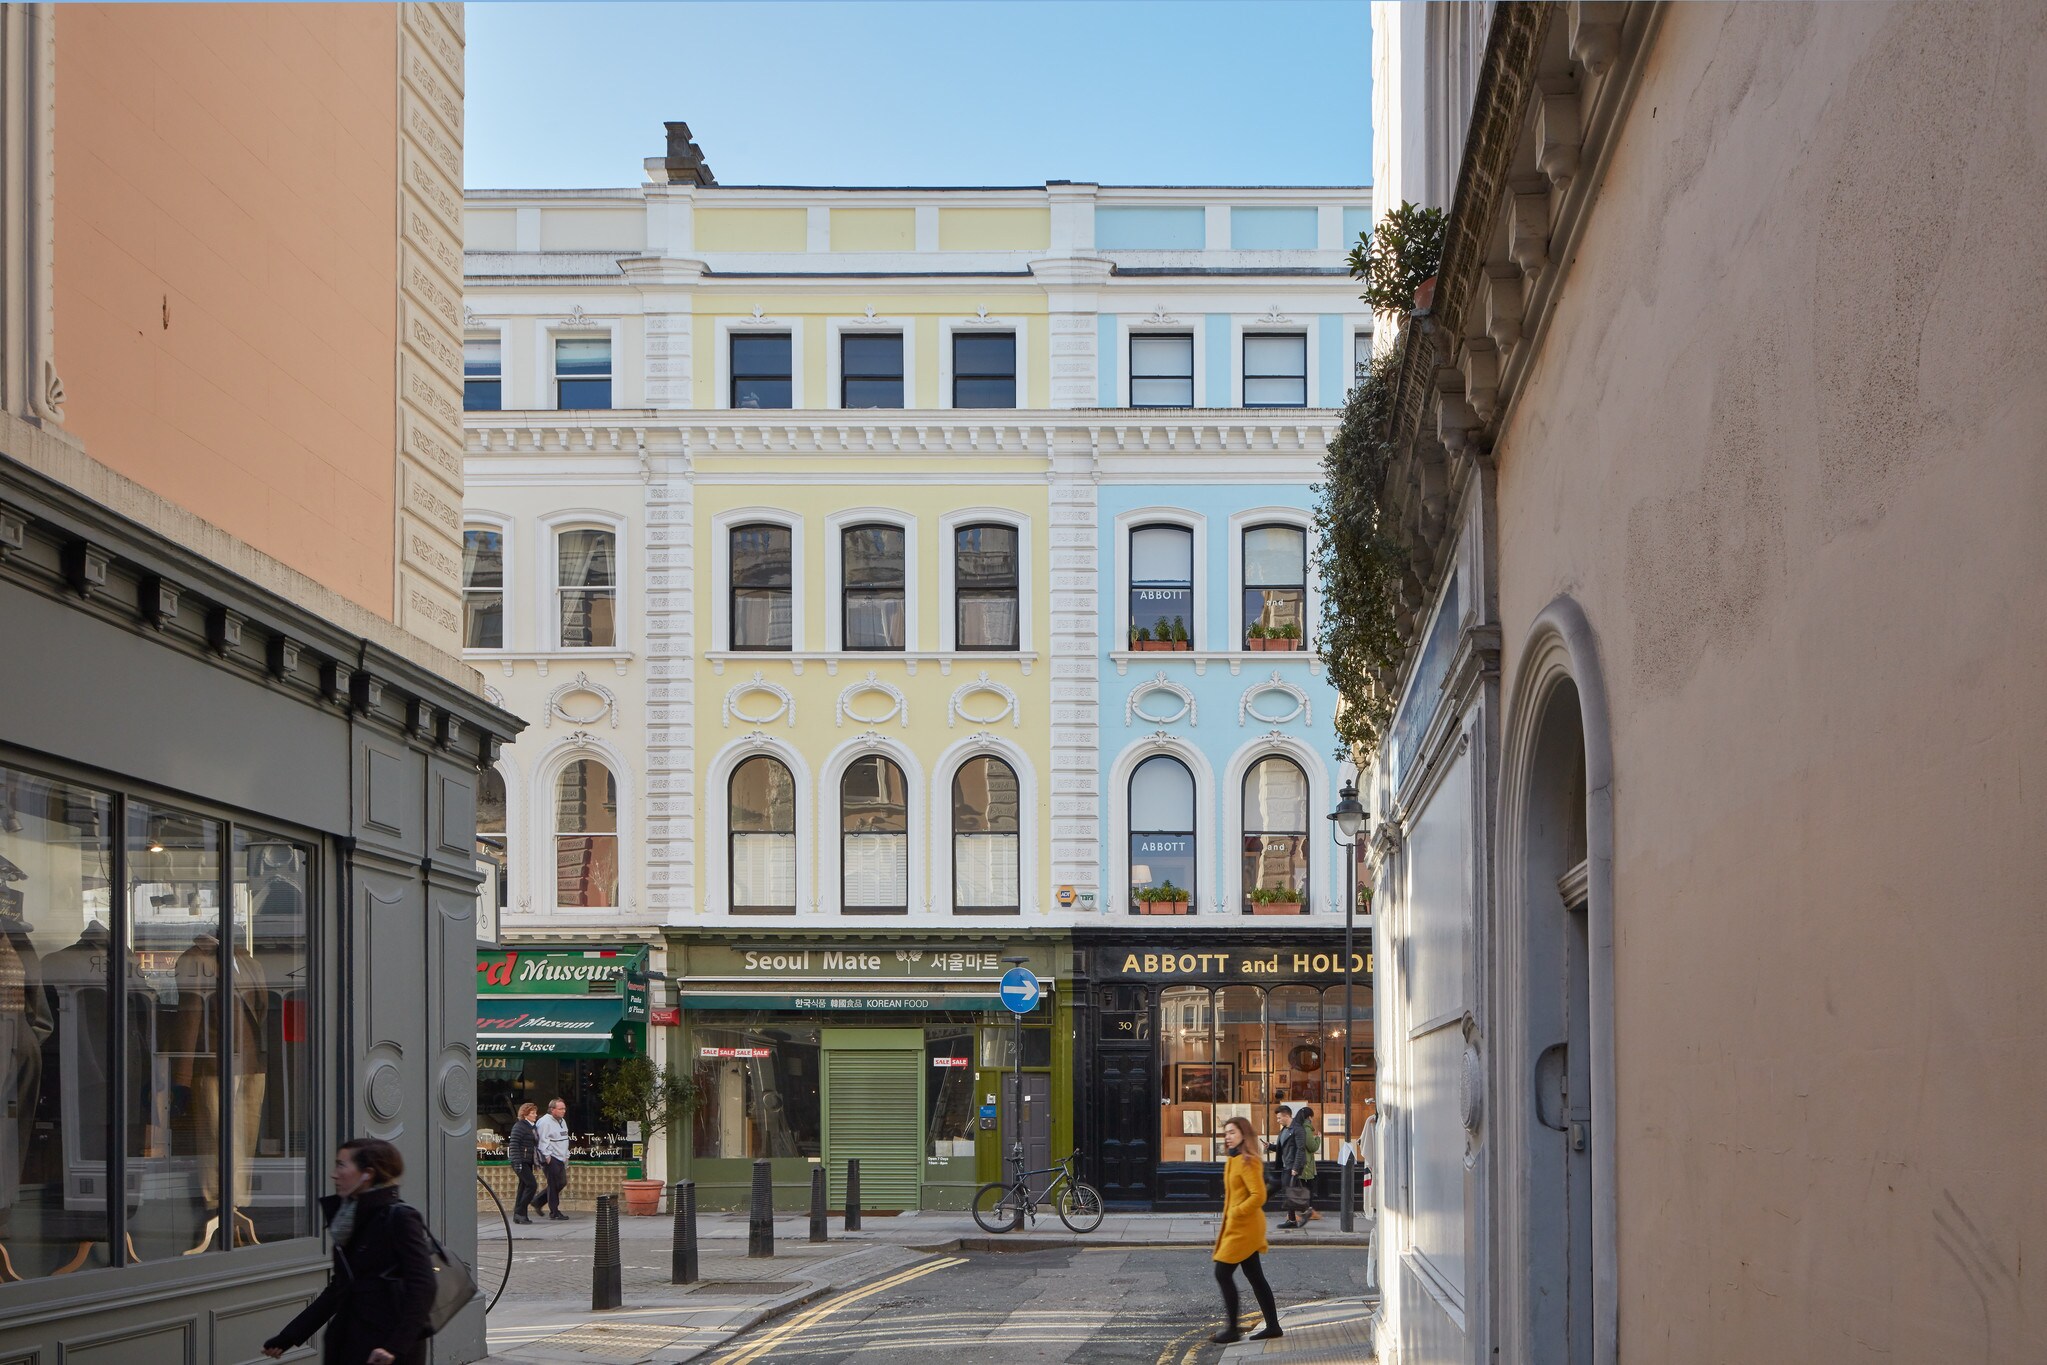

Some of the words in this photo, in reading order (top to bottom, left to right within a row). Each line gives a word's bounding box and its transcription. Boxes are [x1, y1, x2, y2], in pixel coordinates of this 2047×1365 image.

[1140, 591, 1183, 600] ABBOTT
[1266, 598, 1284, 606] and
[1141, 842, 1186, 851] ABBOTT
[1267, 842, 1285, 851] and
[744, 950, 809, 970] Seoul
[823, 950, 881, 970] Mate
[930, 953, 999, 972] 서울마트
[1122, 954, 1230, 973] ABBOTT
[1241, 954, 1278, 973] and
[795, 998, 827, 1009] 한국식품
[866, 999, 902, 1009] KOREAN
[903, 999, 929, 1009] FOOD
[519, 1016, 595, 1029] Museum
[1117, 1020, 1133, 1031] 30
[477, 1041, 507, 1051] arne
[520, 1041, 556, 1051] Pesce
[476, 1146, 505, 1159] Parla
[569, 1145, 588, 1156] abla
[589, 1144, 620, 1158] Español
